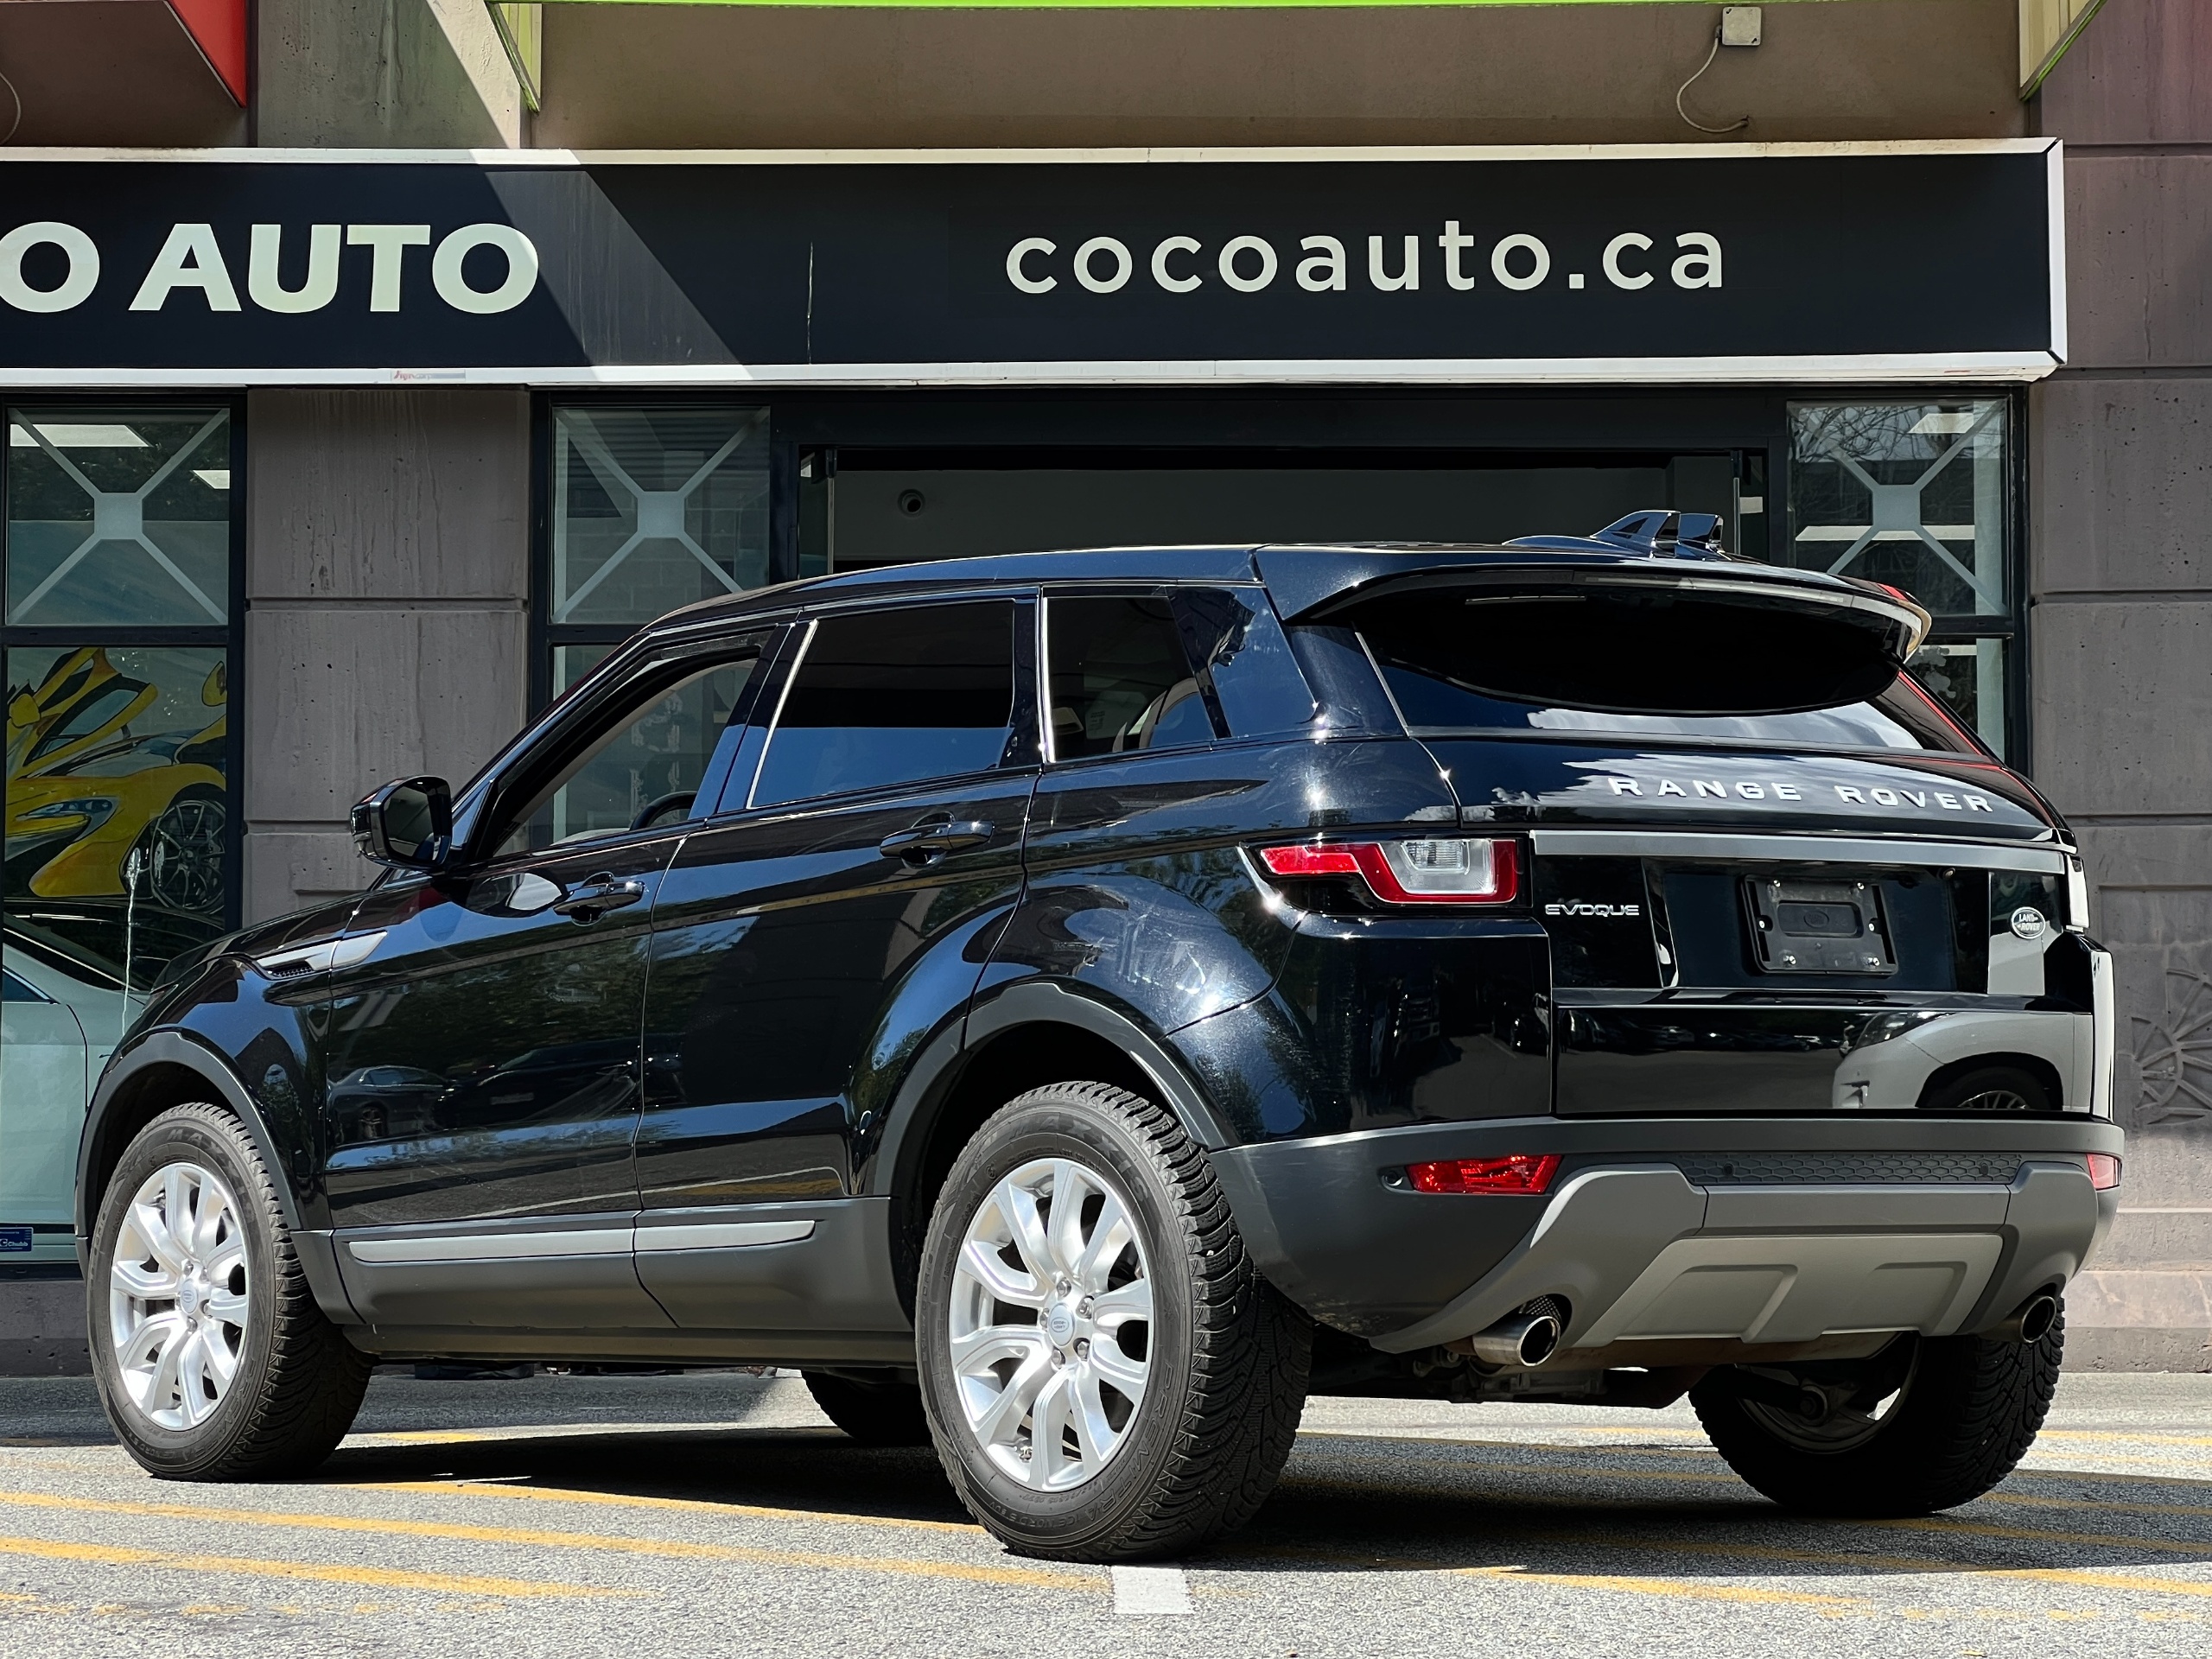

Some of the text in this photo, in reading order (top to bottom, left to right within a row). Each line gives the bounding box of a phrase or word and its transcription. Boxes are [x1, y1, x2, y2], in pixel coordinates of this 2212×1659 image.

[0, 222, 539, 314] O AUTO
[1006, 220, 1722, 294] cocoauto.ca
[1607, 777, 1993, 813] RANGE ROVER
[1545, 904, 1640, 917] EVOQUE
[2018, 913, 2036, 922] LAND
[2020, 922, 2041, 931] ROVER
[1008, 1113, 1148, 1202] MAXXIS
[1084, 1362, 1174, 1521] PREMITRA
